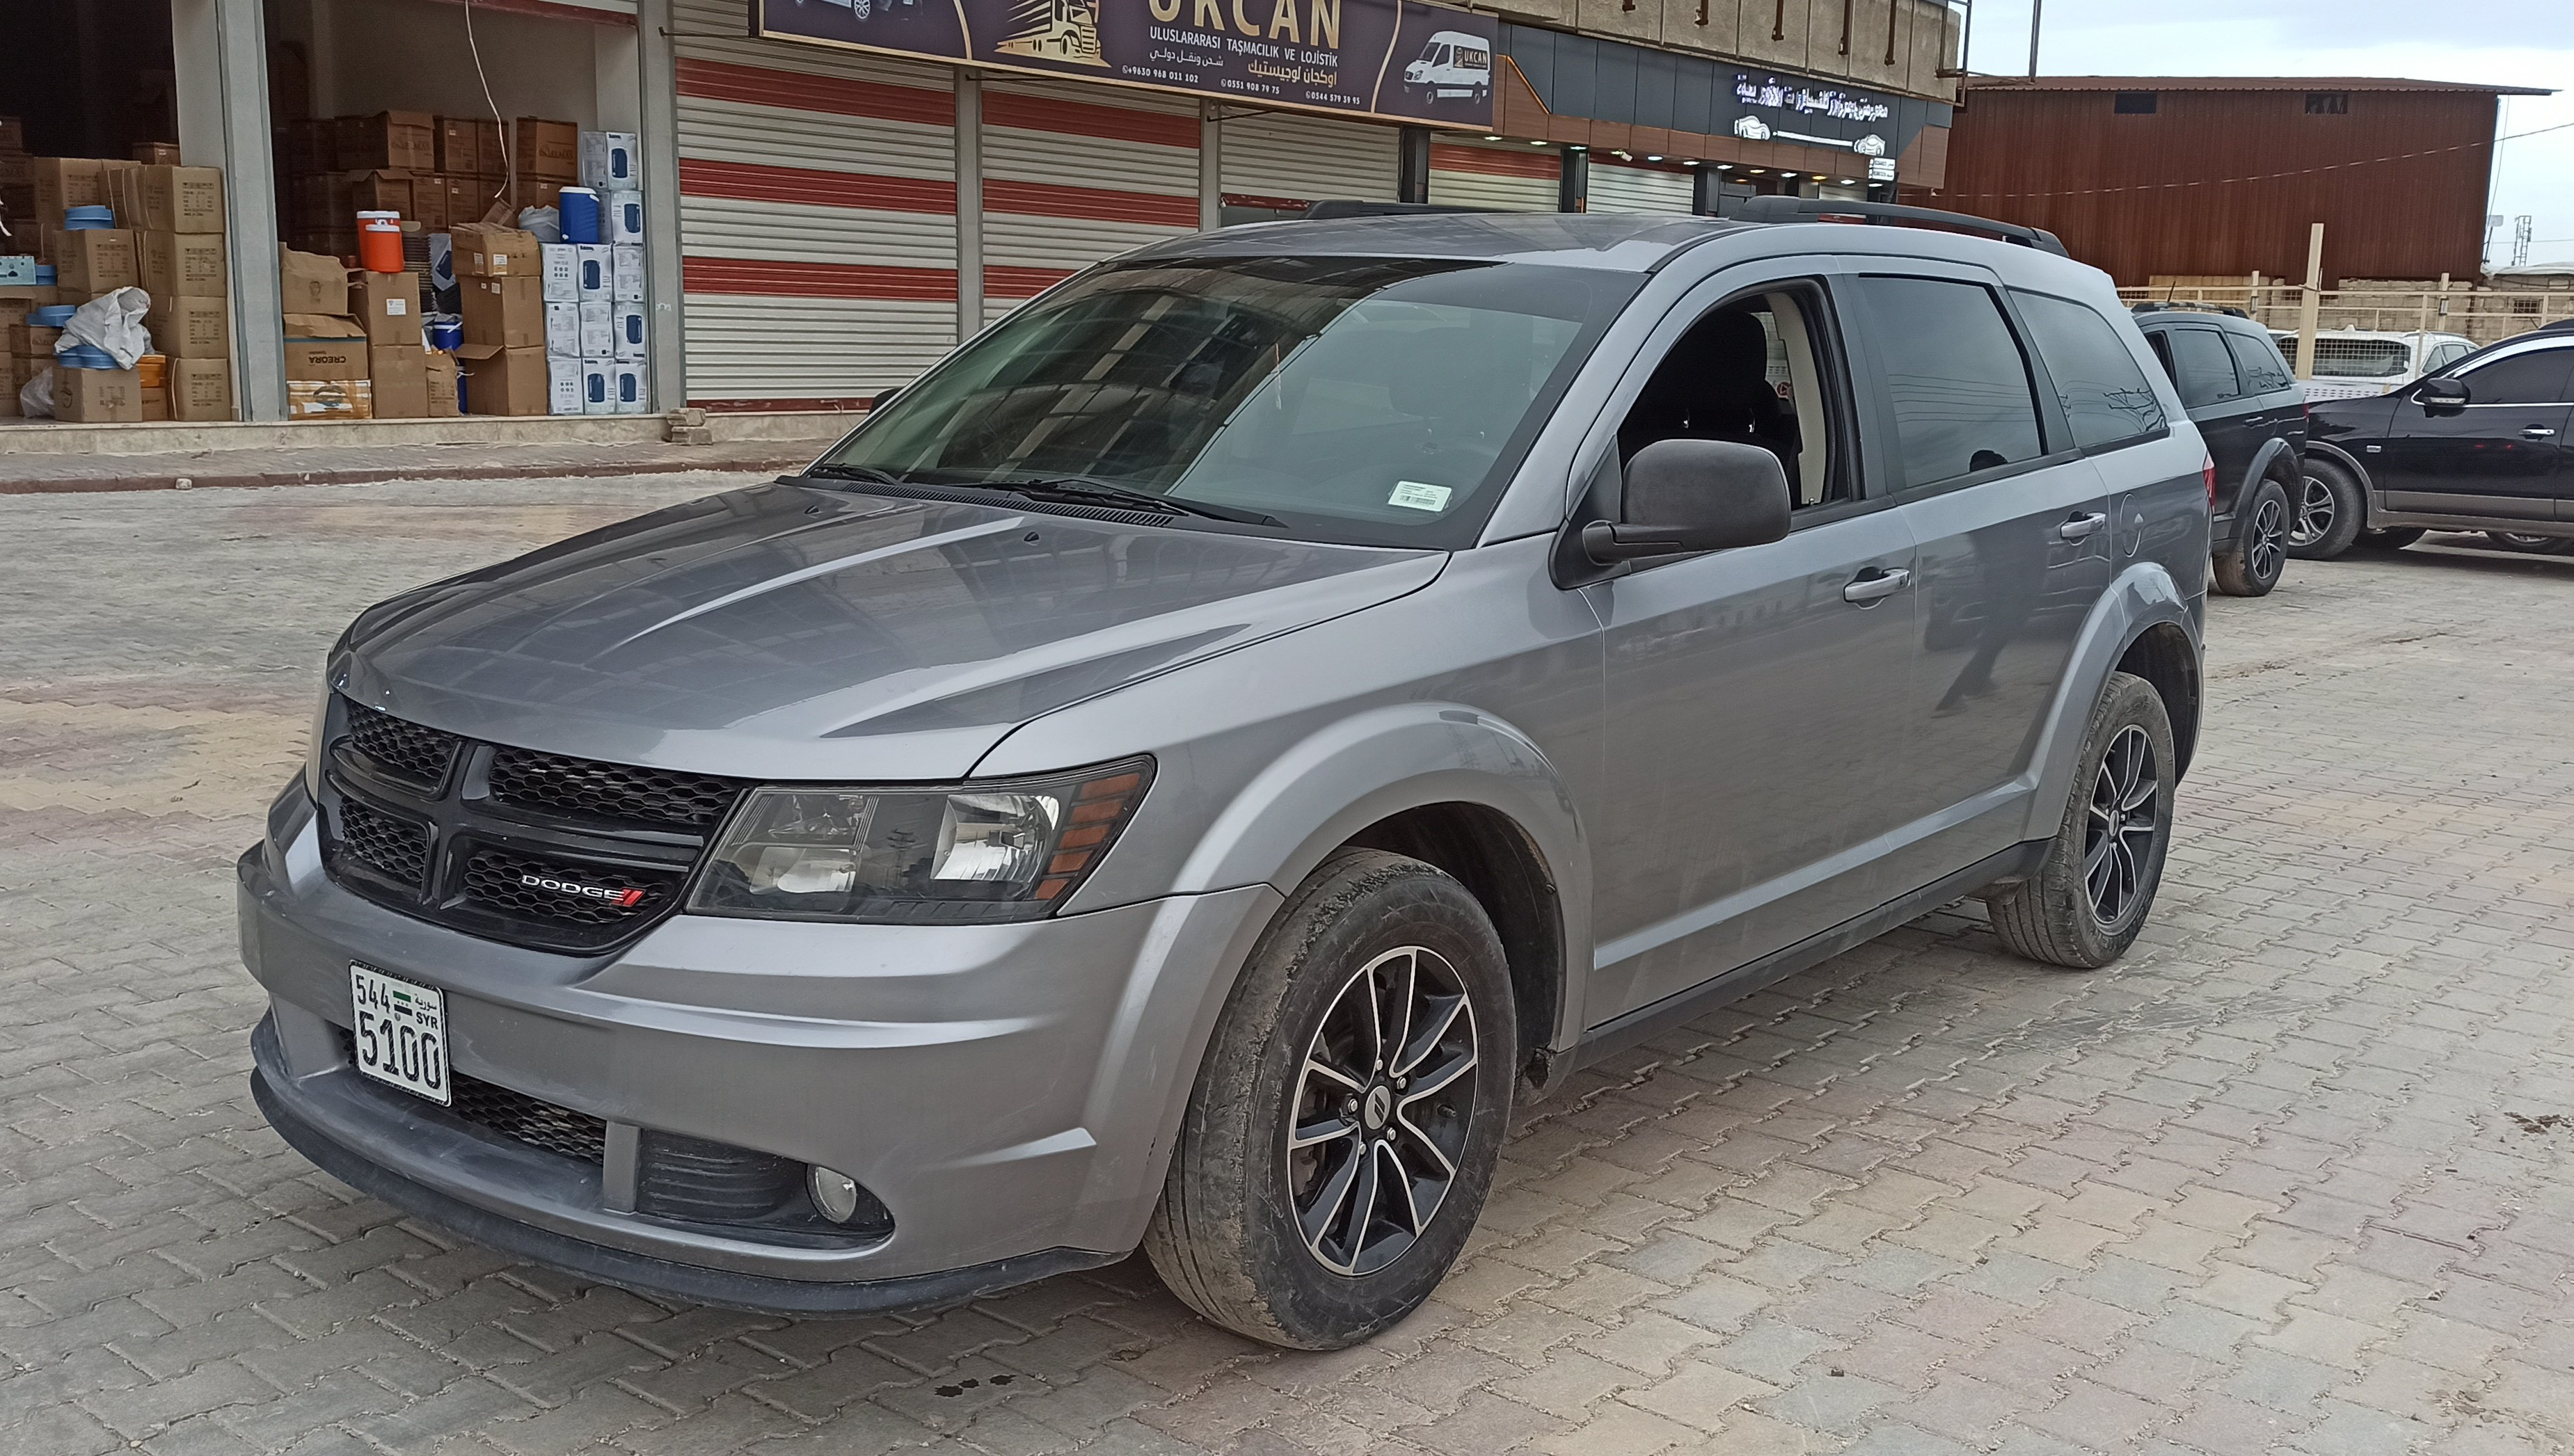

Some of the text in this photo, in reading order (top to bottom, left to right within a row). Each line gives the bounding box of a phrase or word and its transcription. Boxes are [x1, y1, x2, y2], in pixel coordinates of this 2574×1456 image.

[1150, 26, 1338, 67] ULUSLARARASI TAŞMACILIK VE LOJİSTİK
[1150, 47, 1224, 67] شحن ونقل دولي
[1128, 66, 1199, 83] +9630 968 011 102
[1248, 58, 1337, 88] اوكجان لوجيستيك
[1227, 80, 1244, 90] 0551
[1272, 86, 1280, 95] 75
[308, 355, 347, 364] CREORA
[522, 874, 625, 901] DODGE
[356, 974, 390, 1014] 544
[415, 993, 437, 1011] سورية
[416, 1011, 438, 1030] SYR
[359, 1010, 441, 1089] 5100
